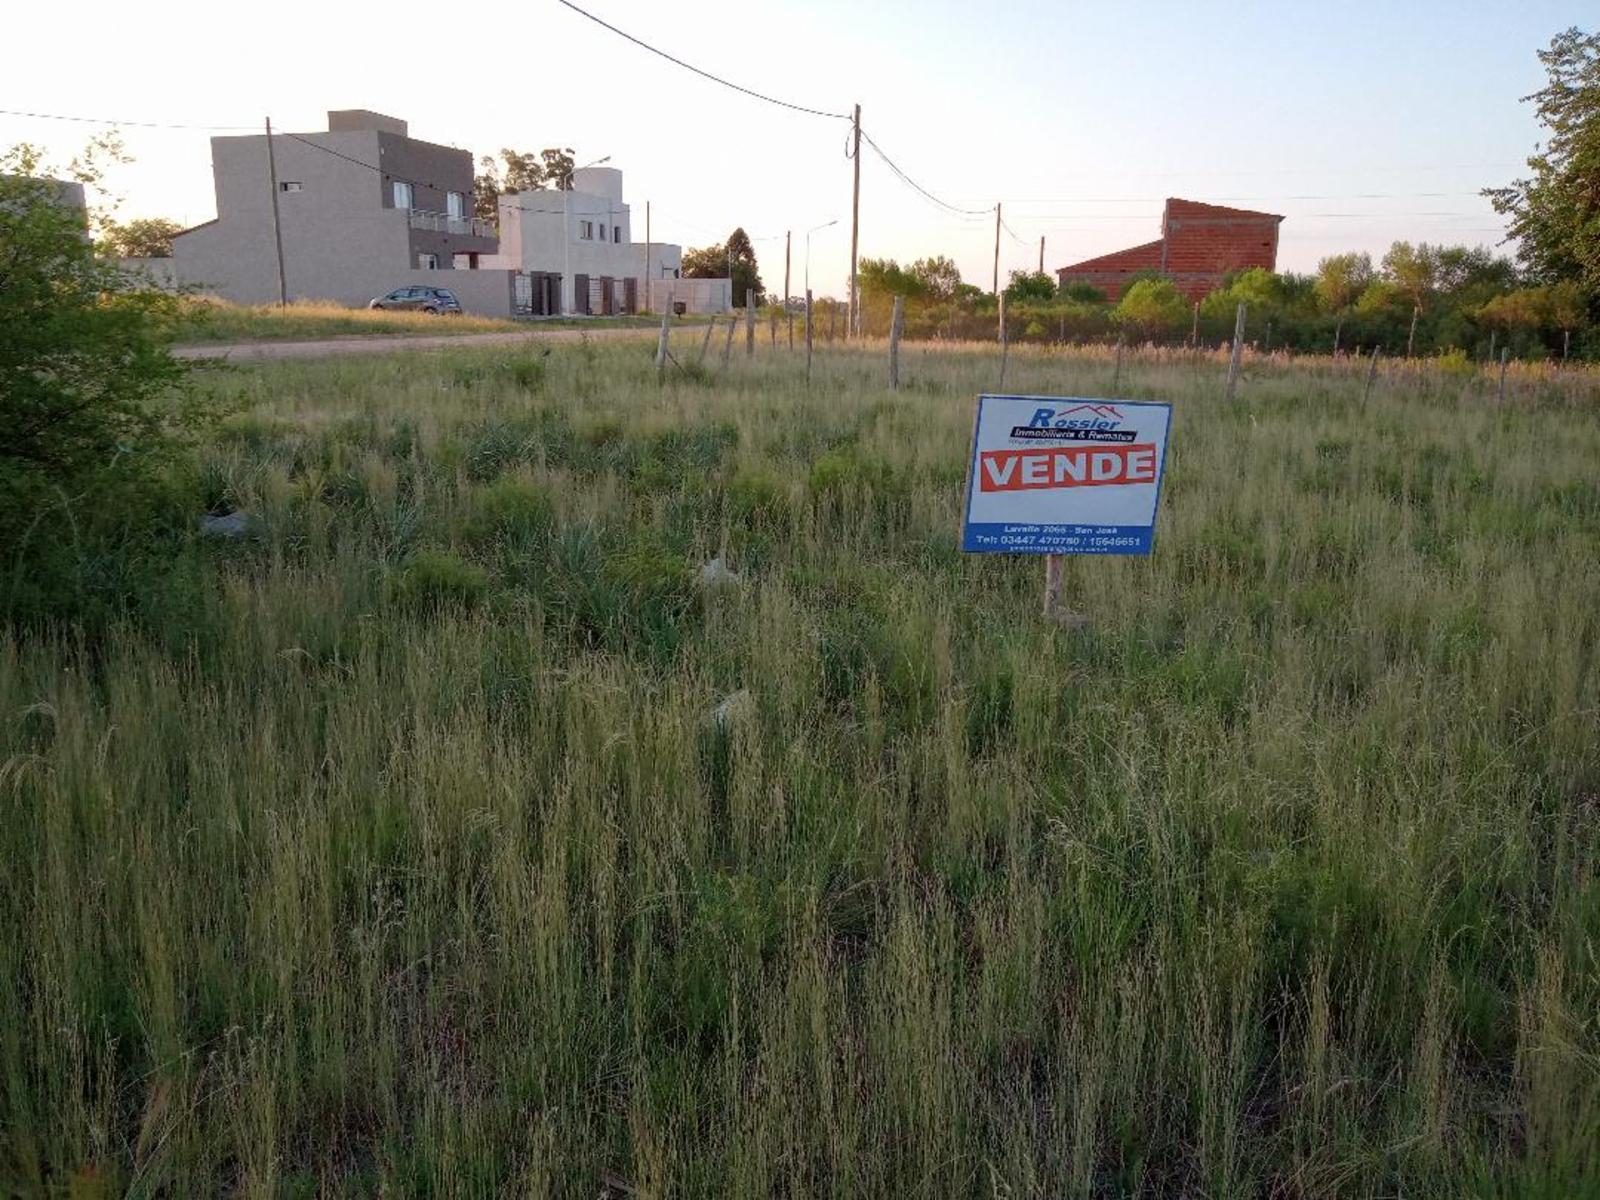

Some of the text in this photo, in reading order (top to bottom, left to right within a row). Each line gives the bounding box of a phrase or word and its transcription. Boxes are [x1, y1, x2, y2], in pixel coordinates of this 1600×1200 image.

[983, 450, 1155, 486] VENDE
[1075, 526, 1093, 534] San
[1000, 535, 1036, 545] 03447
